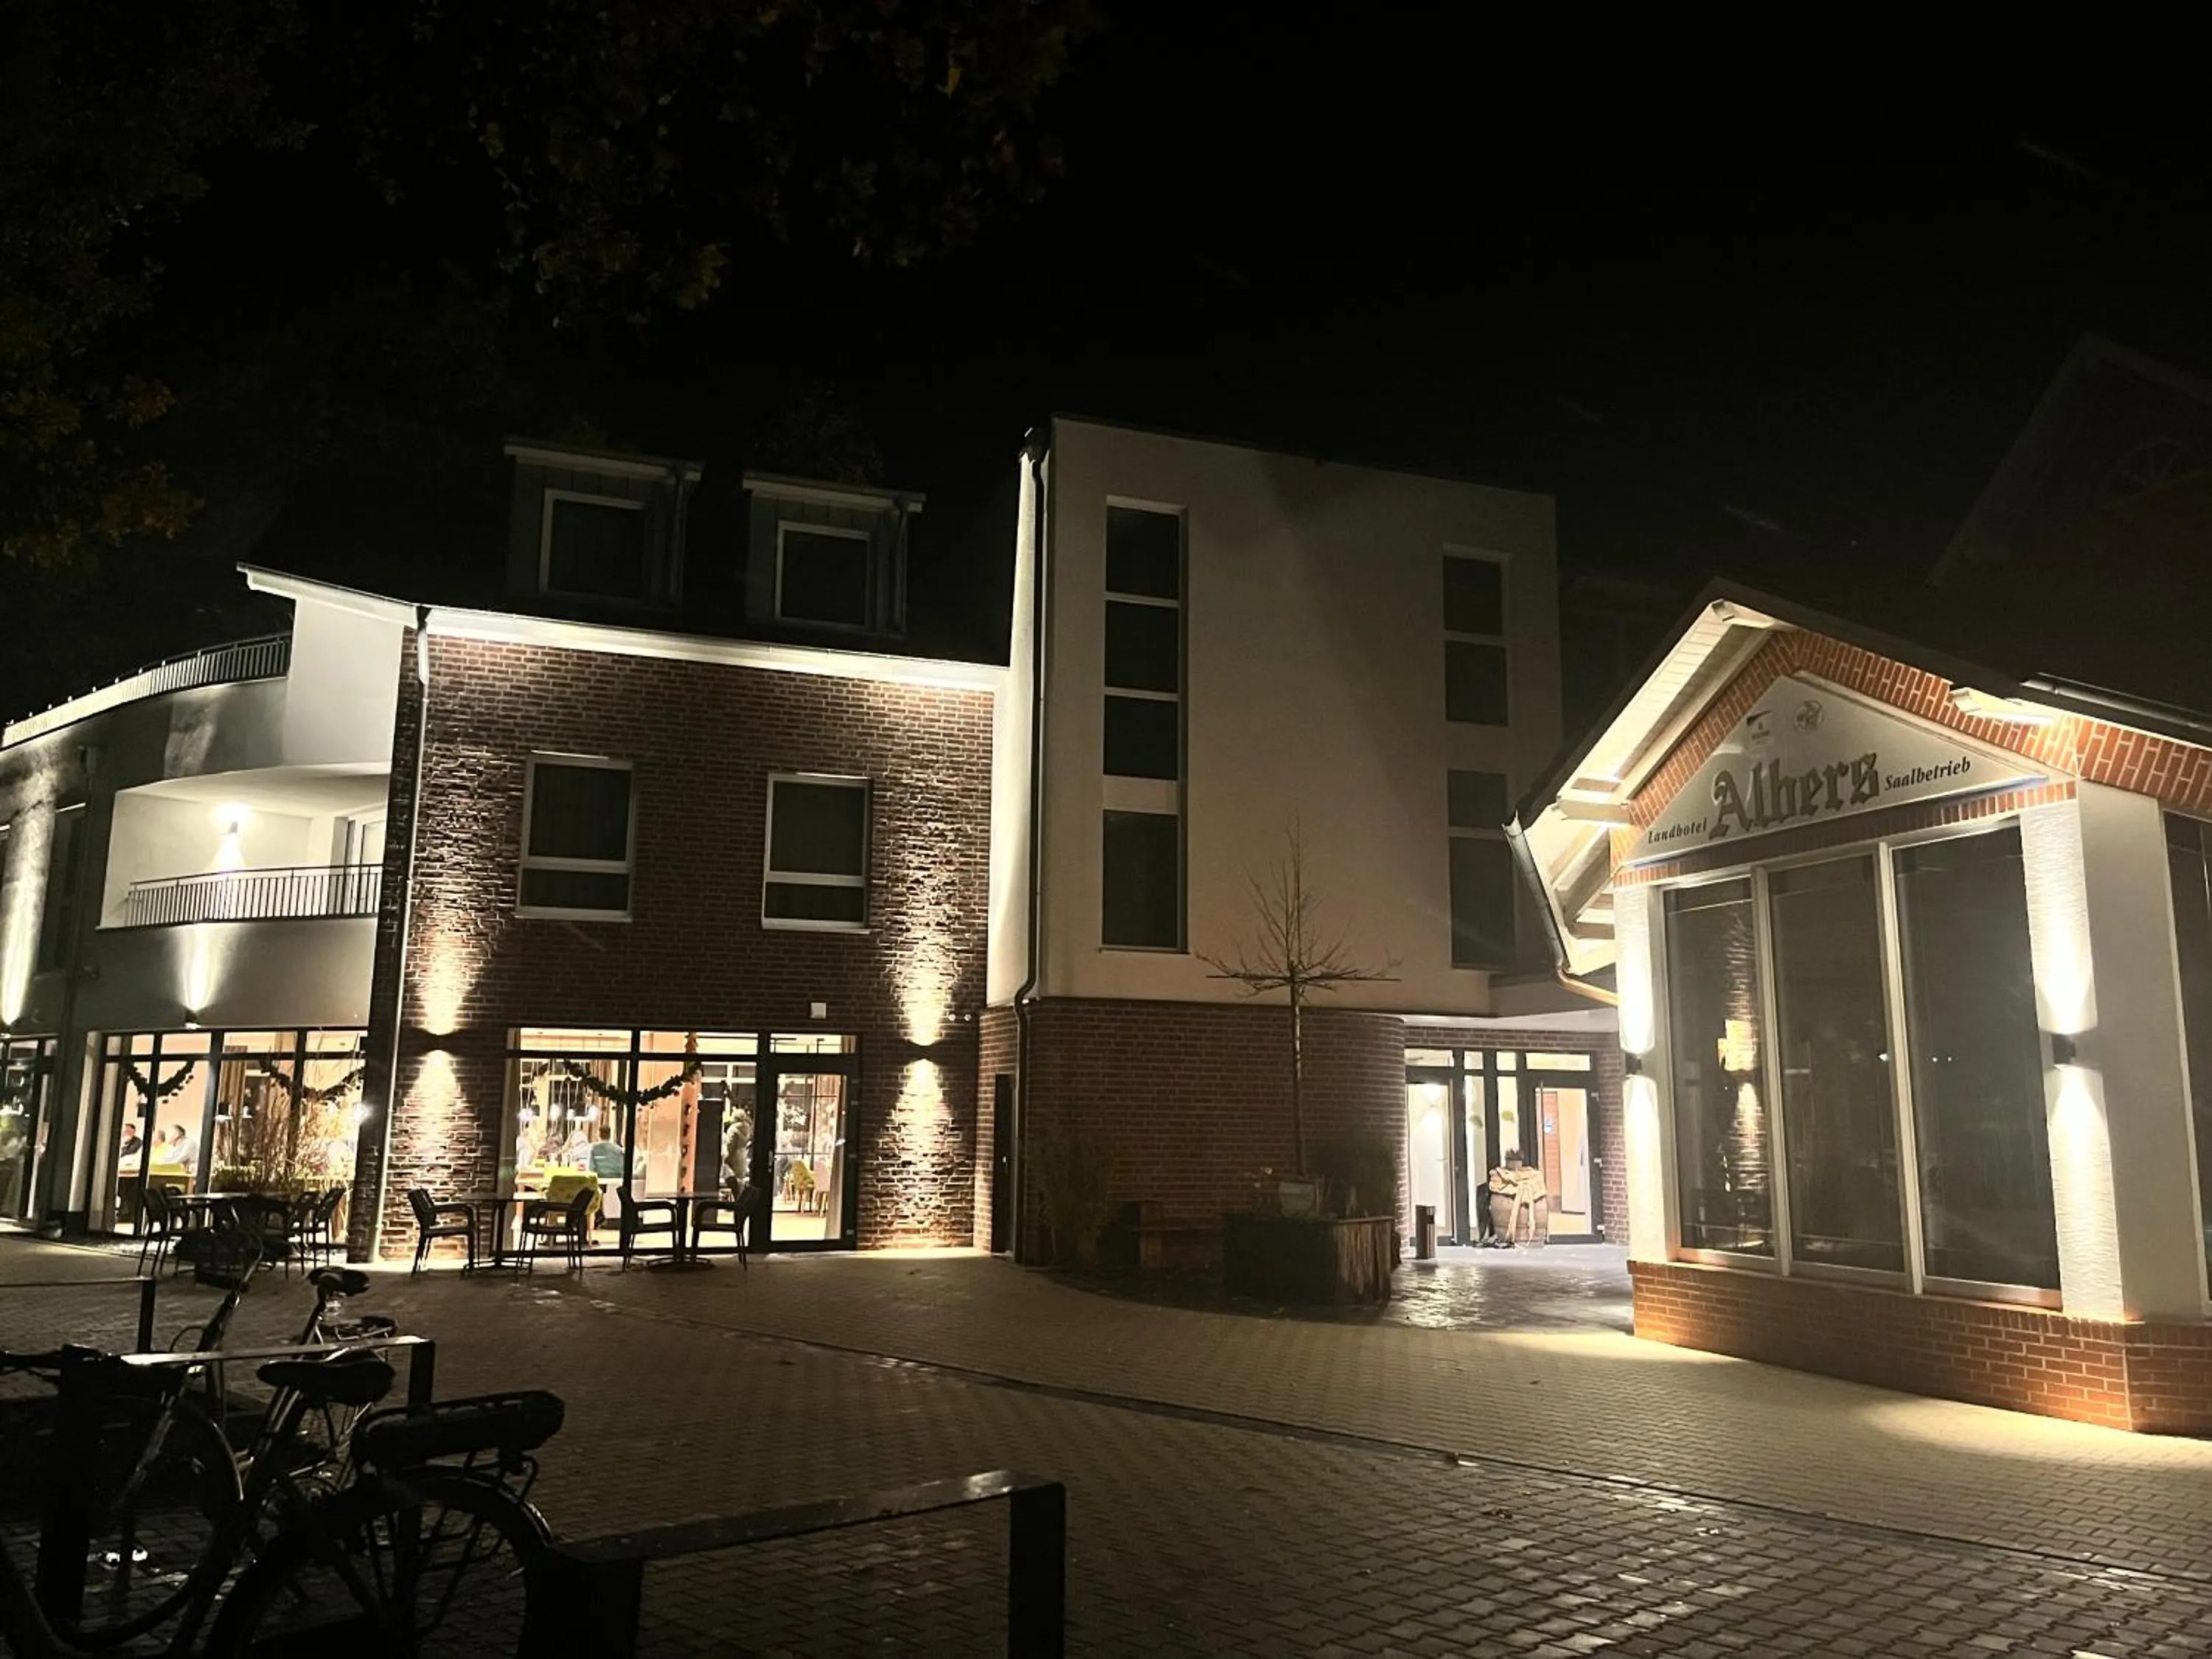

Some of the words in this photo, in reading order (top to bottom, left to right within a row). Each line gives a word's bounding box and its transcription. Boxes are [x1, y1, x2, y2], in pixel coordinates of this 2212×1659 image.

[1647, 816, 1708, 844] Landhotel
[1708, 753, 1879, 841] Albers
[1884, 756, 1971, 791] Saalbetrieb
